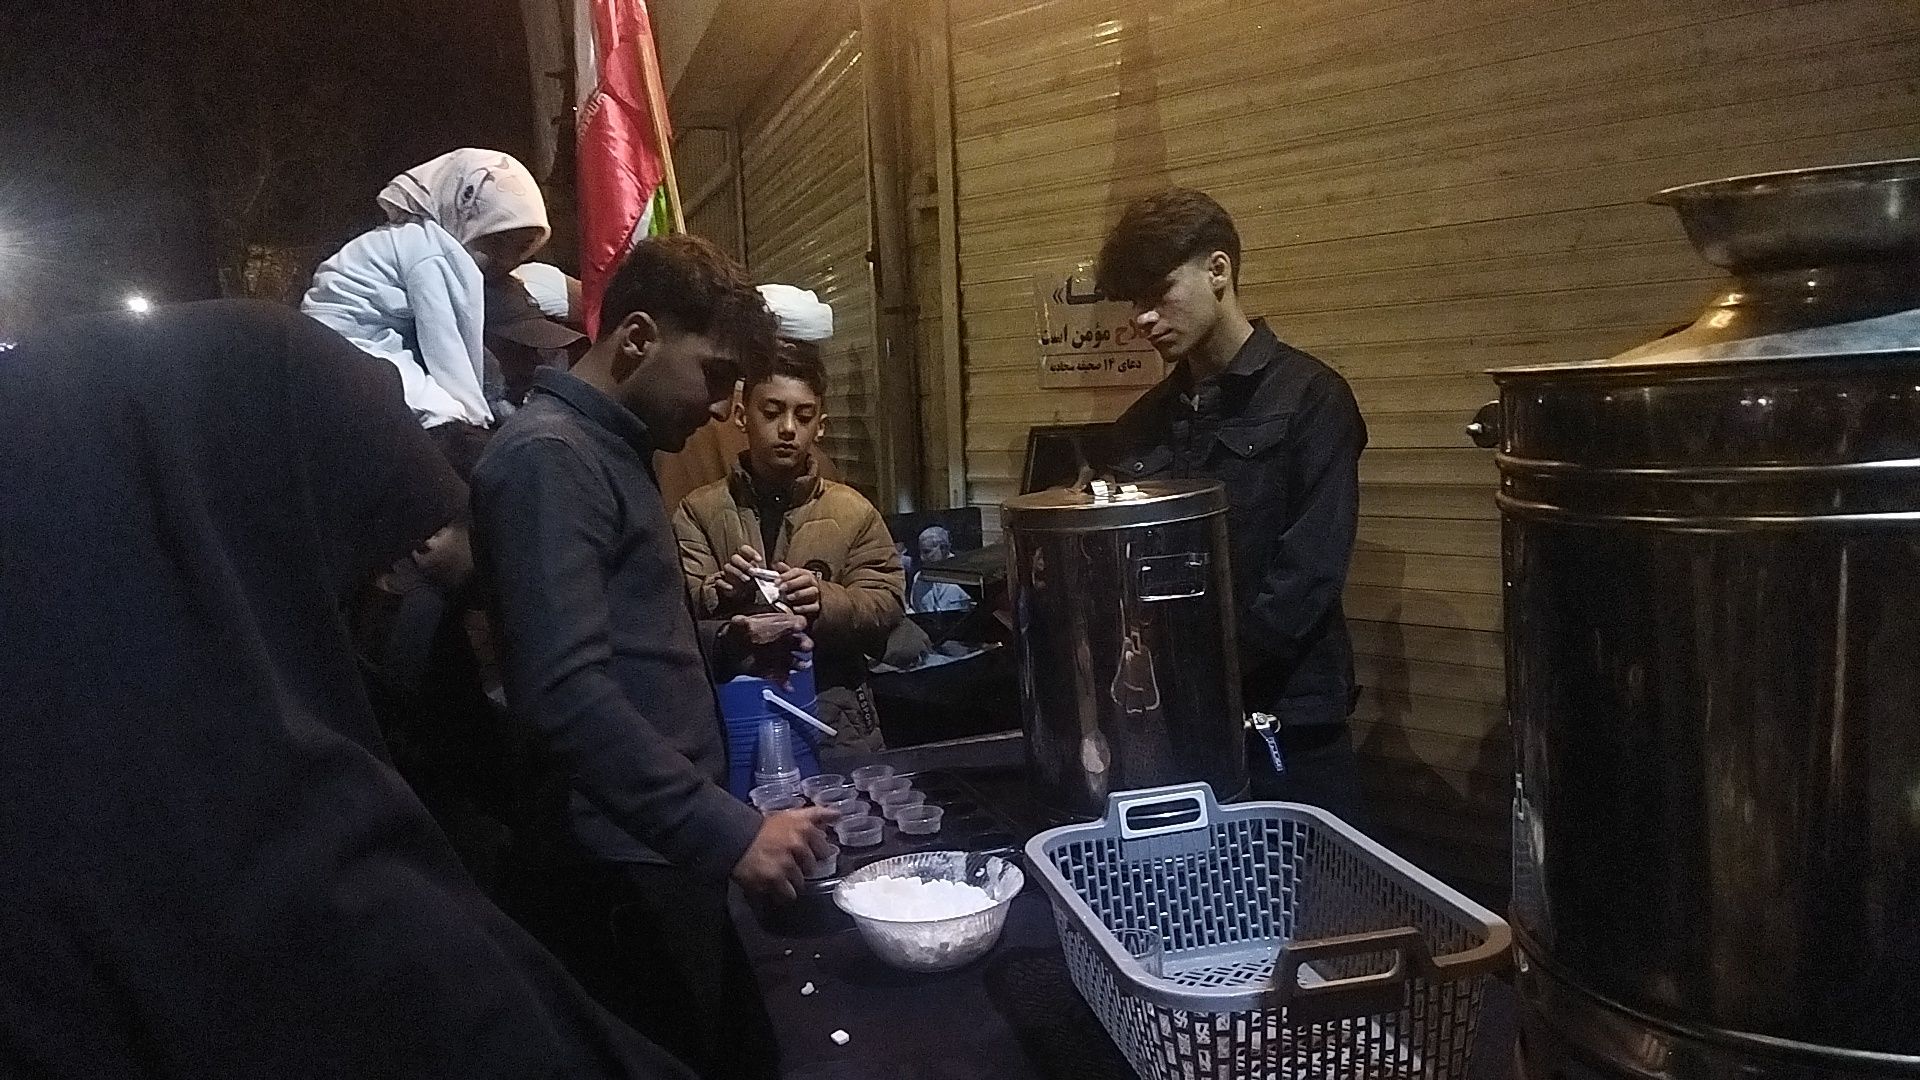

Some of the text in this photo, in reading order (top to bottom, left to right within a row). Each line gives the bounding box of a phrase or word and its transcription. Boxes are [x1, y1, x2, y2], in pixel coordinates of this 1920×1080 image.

[1041, 324, 1068, 346] است
[1072, 322, 1110, 348] مؤمن
[1117, 358, 1142, 373] دعای
